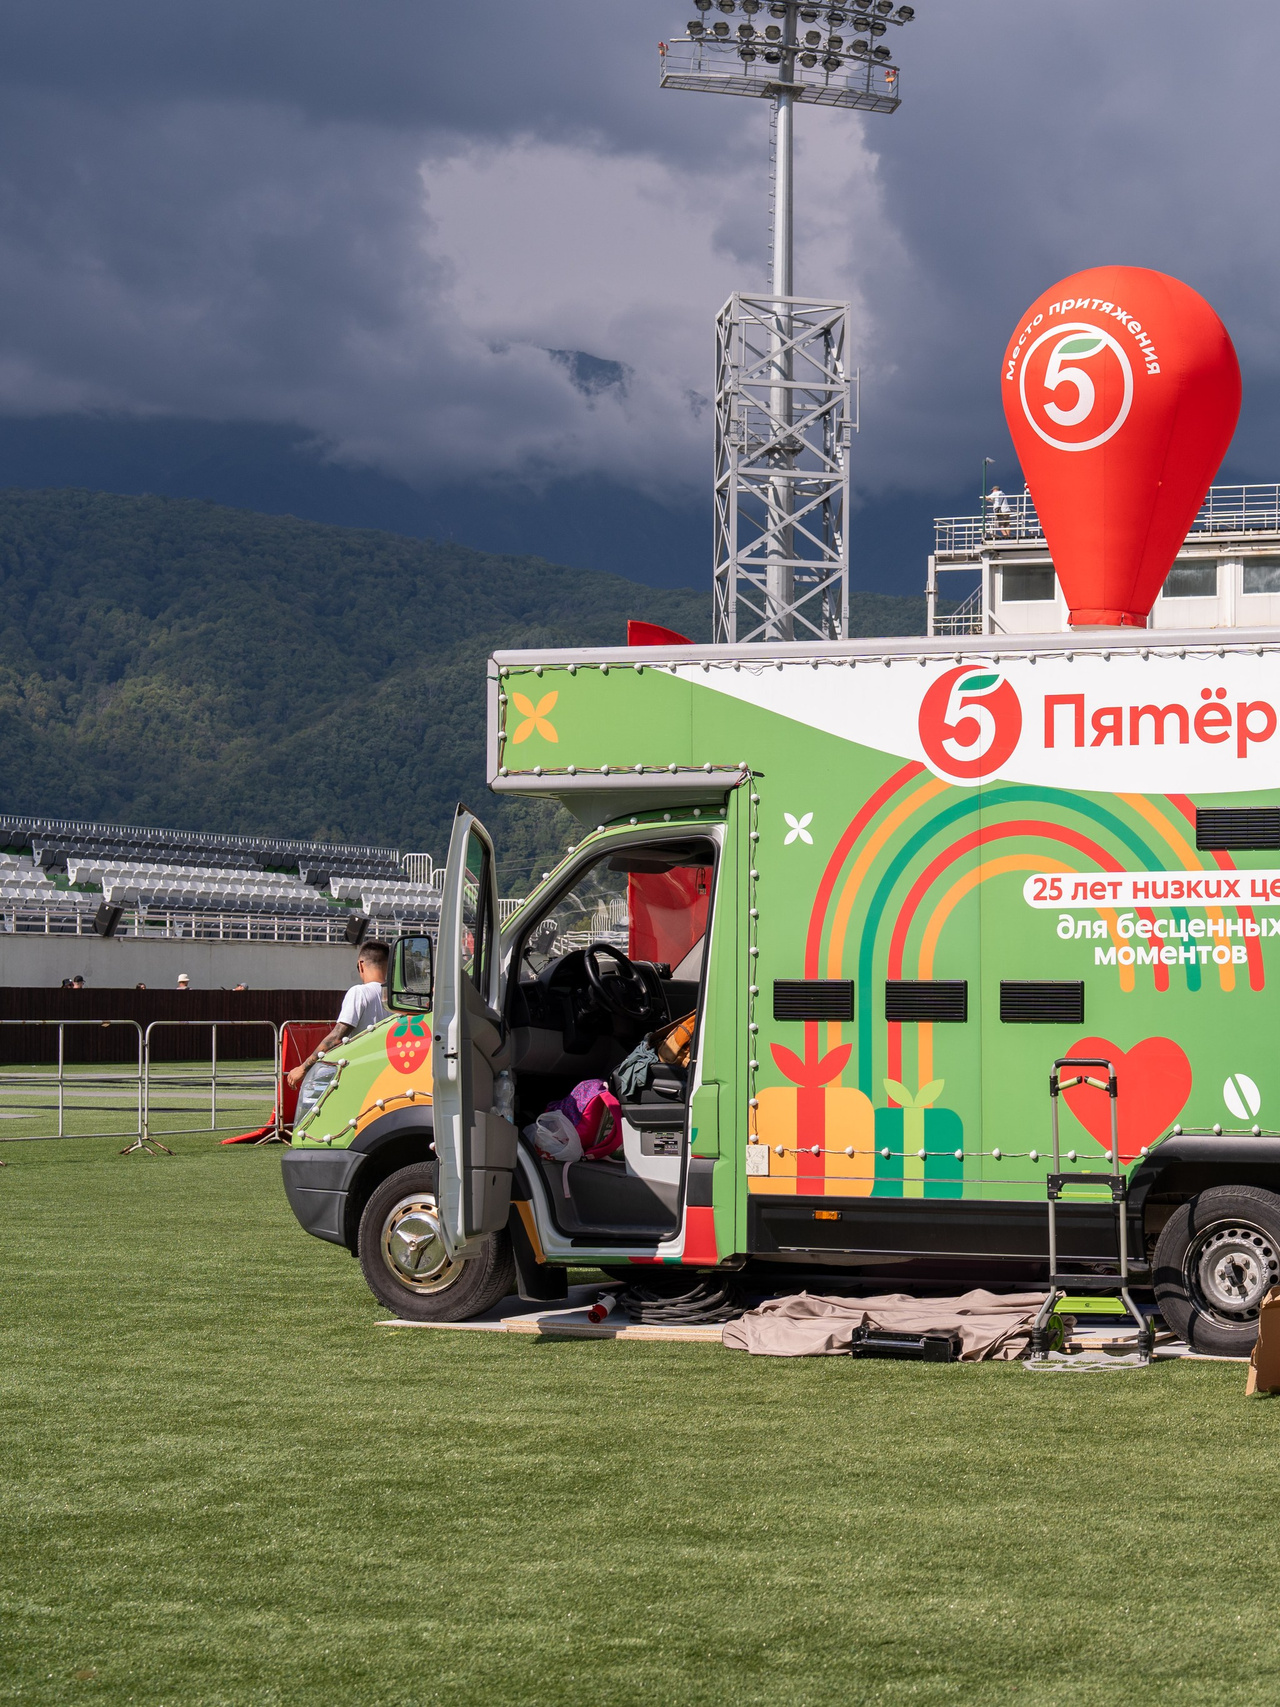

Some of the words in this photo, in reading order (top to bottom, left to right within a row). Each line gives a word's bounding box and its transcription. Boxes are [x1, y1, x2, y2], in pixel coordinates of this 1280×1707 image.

[1048, 297, 1161, 375] притяжения
[1033, 877, 1063, 901] 25
[1071, 880, 1123, 900] лет
[1132, 879, 1241, 900] низких
[1056, 913, 1108, 940] для
[1094, 945, 1248, 966] моментов
